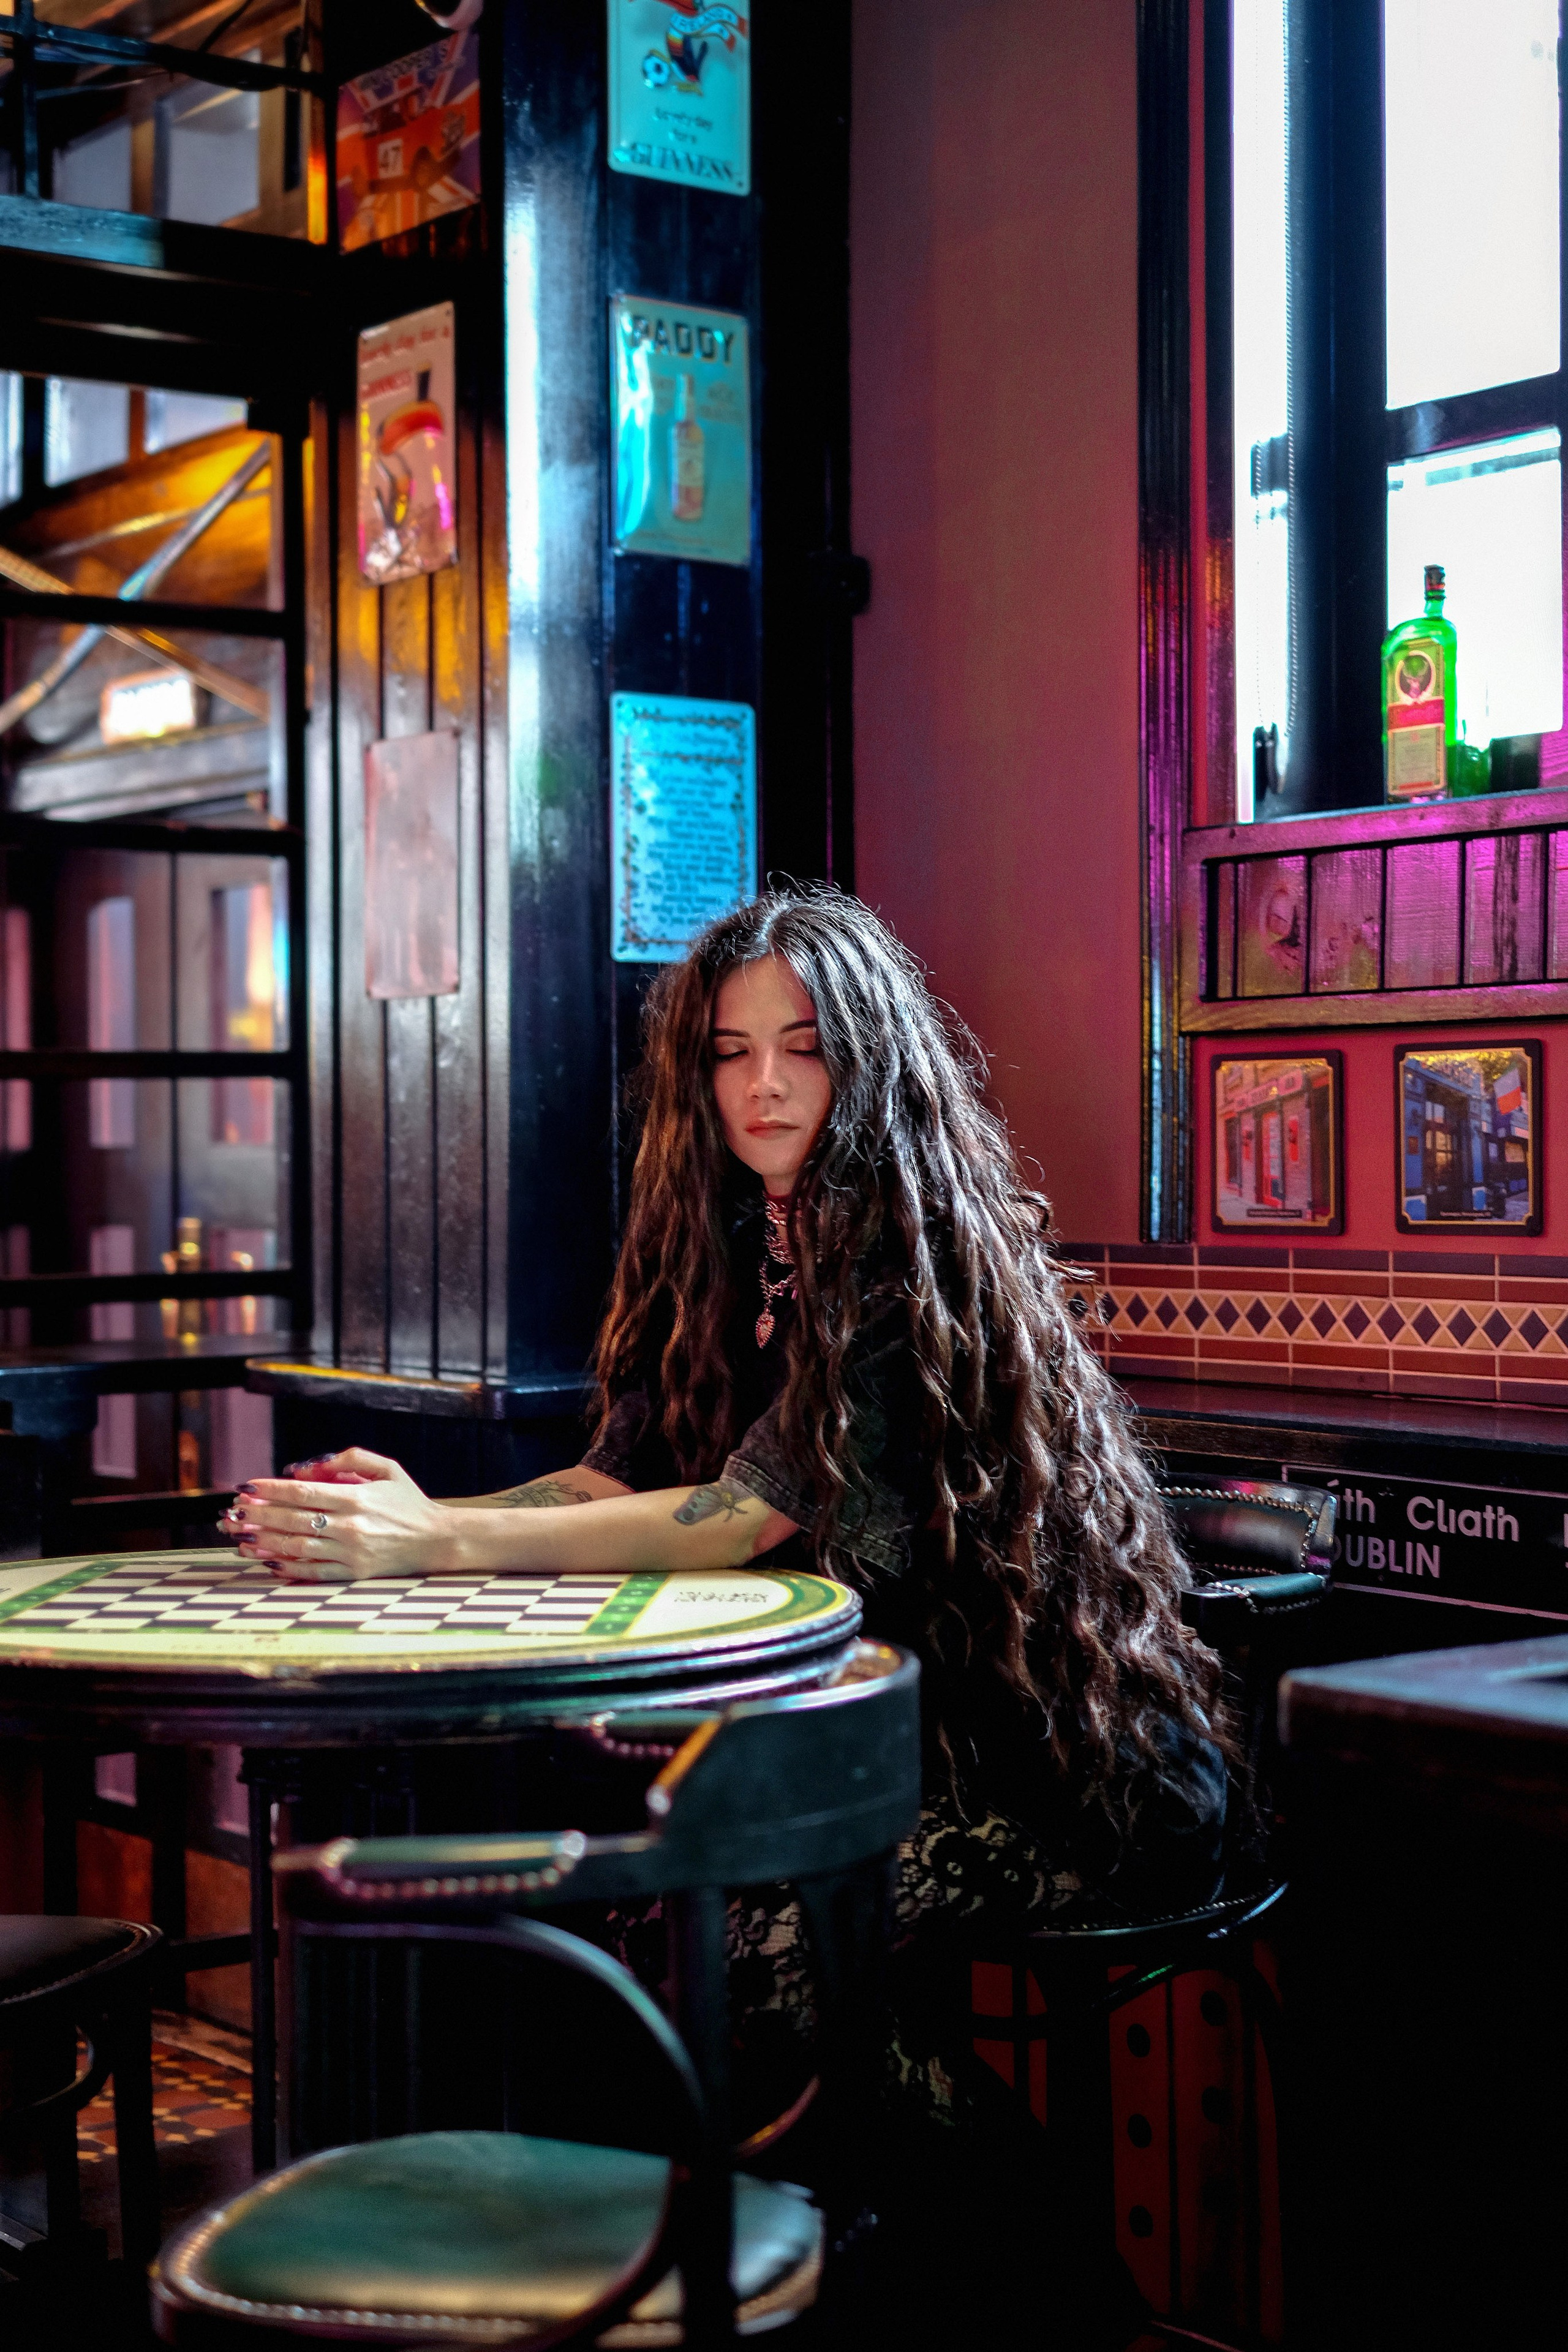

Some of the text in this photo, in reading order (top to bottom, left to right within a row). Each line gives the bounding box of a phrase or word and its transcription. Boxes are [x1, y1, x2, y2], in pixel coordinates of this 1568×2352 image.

[380, 145, 401, 170] 47
[629, 142, 733, 179] GUINNESS
[631, 314, 735, 363] PADDY
[1406, 1495, 1520, 1542] Cliath
